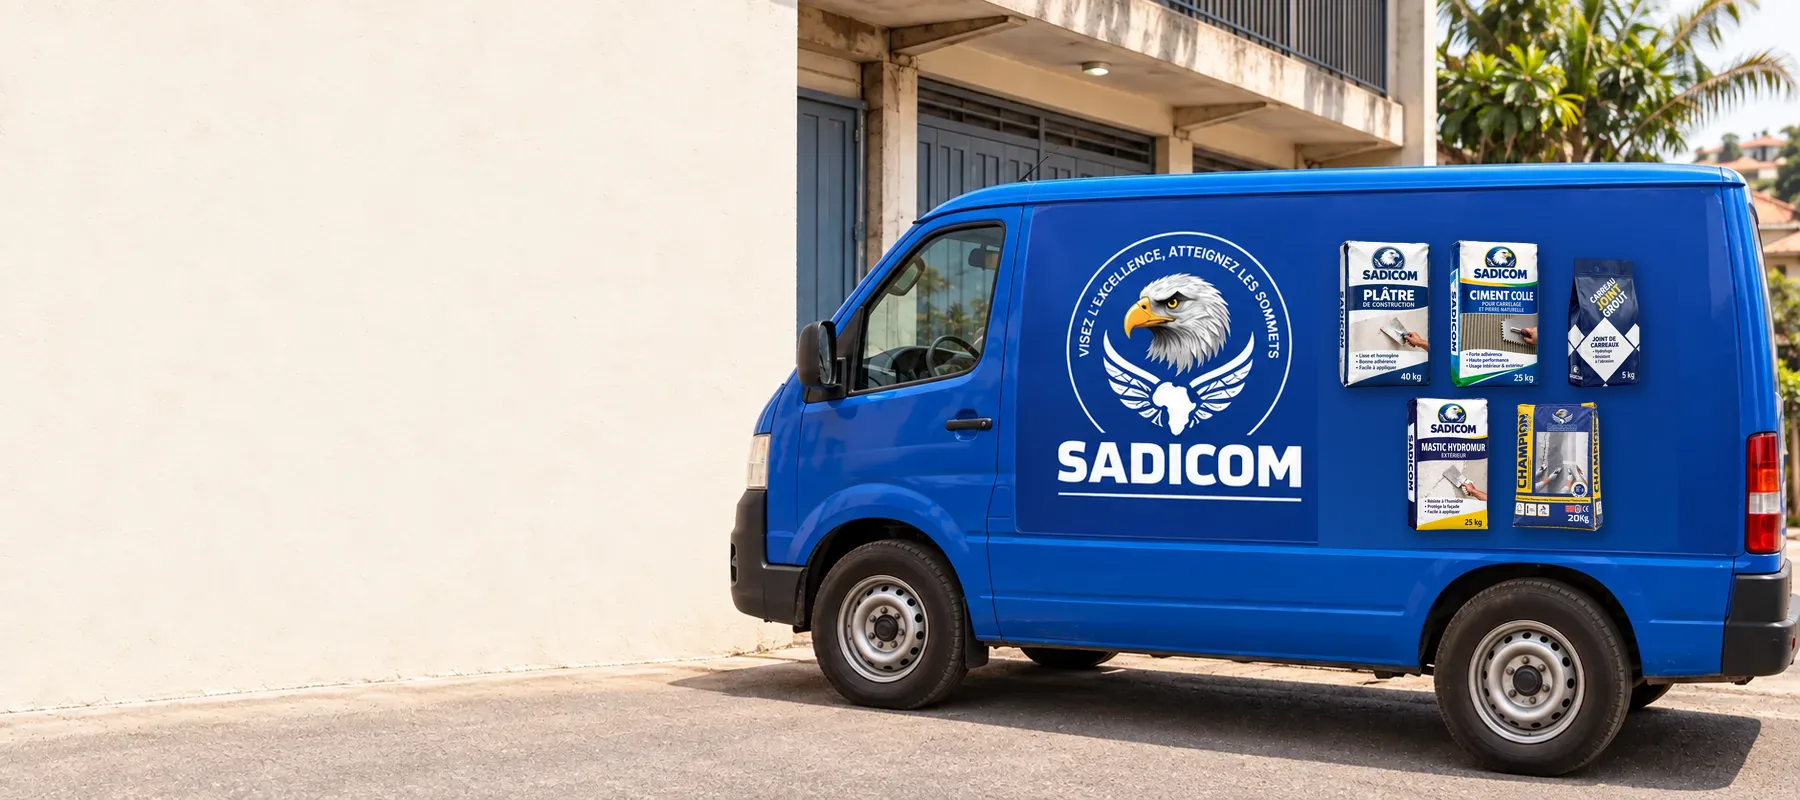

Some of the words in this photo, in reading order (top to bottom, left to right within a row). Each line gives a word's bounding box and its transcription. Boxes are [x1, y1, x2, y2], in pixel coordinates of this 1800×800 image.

[1363, 270, 1417, 281] SADICOM
[1474, 268, 1527, 279] SADICOM
[1364, 286, 1414, 300] PLÂTRE
[1470, 290, 1509, 300] CIMENT
[1511, 291, 1533, 301] COLLE
[1590, 278, 1616, 303] CARREAU
[1080, 318, 1095, 357] VISEZ
[1088, 248, 1166, 316] L'EXCELLENCE,
[1169, 245, 1240, 273] ATTEIGNEZ
[1237, 268, 1259, 292] LES
[1255, 291, 1279, 359] SOMMETS
[1597, 284, 1621, 311] JOINT
[1602, 291, 1627, 317] GROUT
[1412, 373, 1421, 382] kg
[1524, 374, 1534, 383] kg
[1627, 372, 1634, 380] kg
[1431, 424, 1476, 433] SADICOM
[1422, 443, 1446, 451] MASTIC
[1448, 443, 1485, 451] HYDROMUR
[1518, 414, 1528, 488] CHAMPION
[1058, 440, 1302, 488] SADICOM
[1568, 515, 1589, 523] 20Kg
